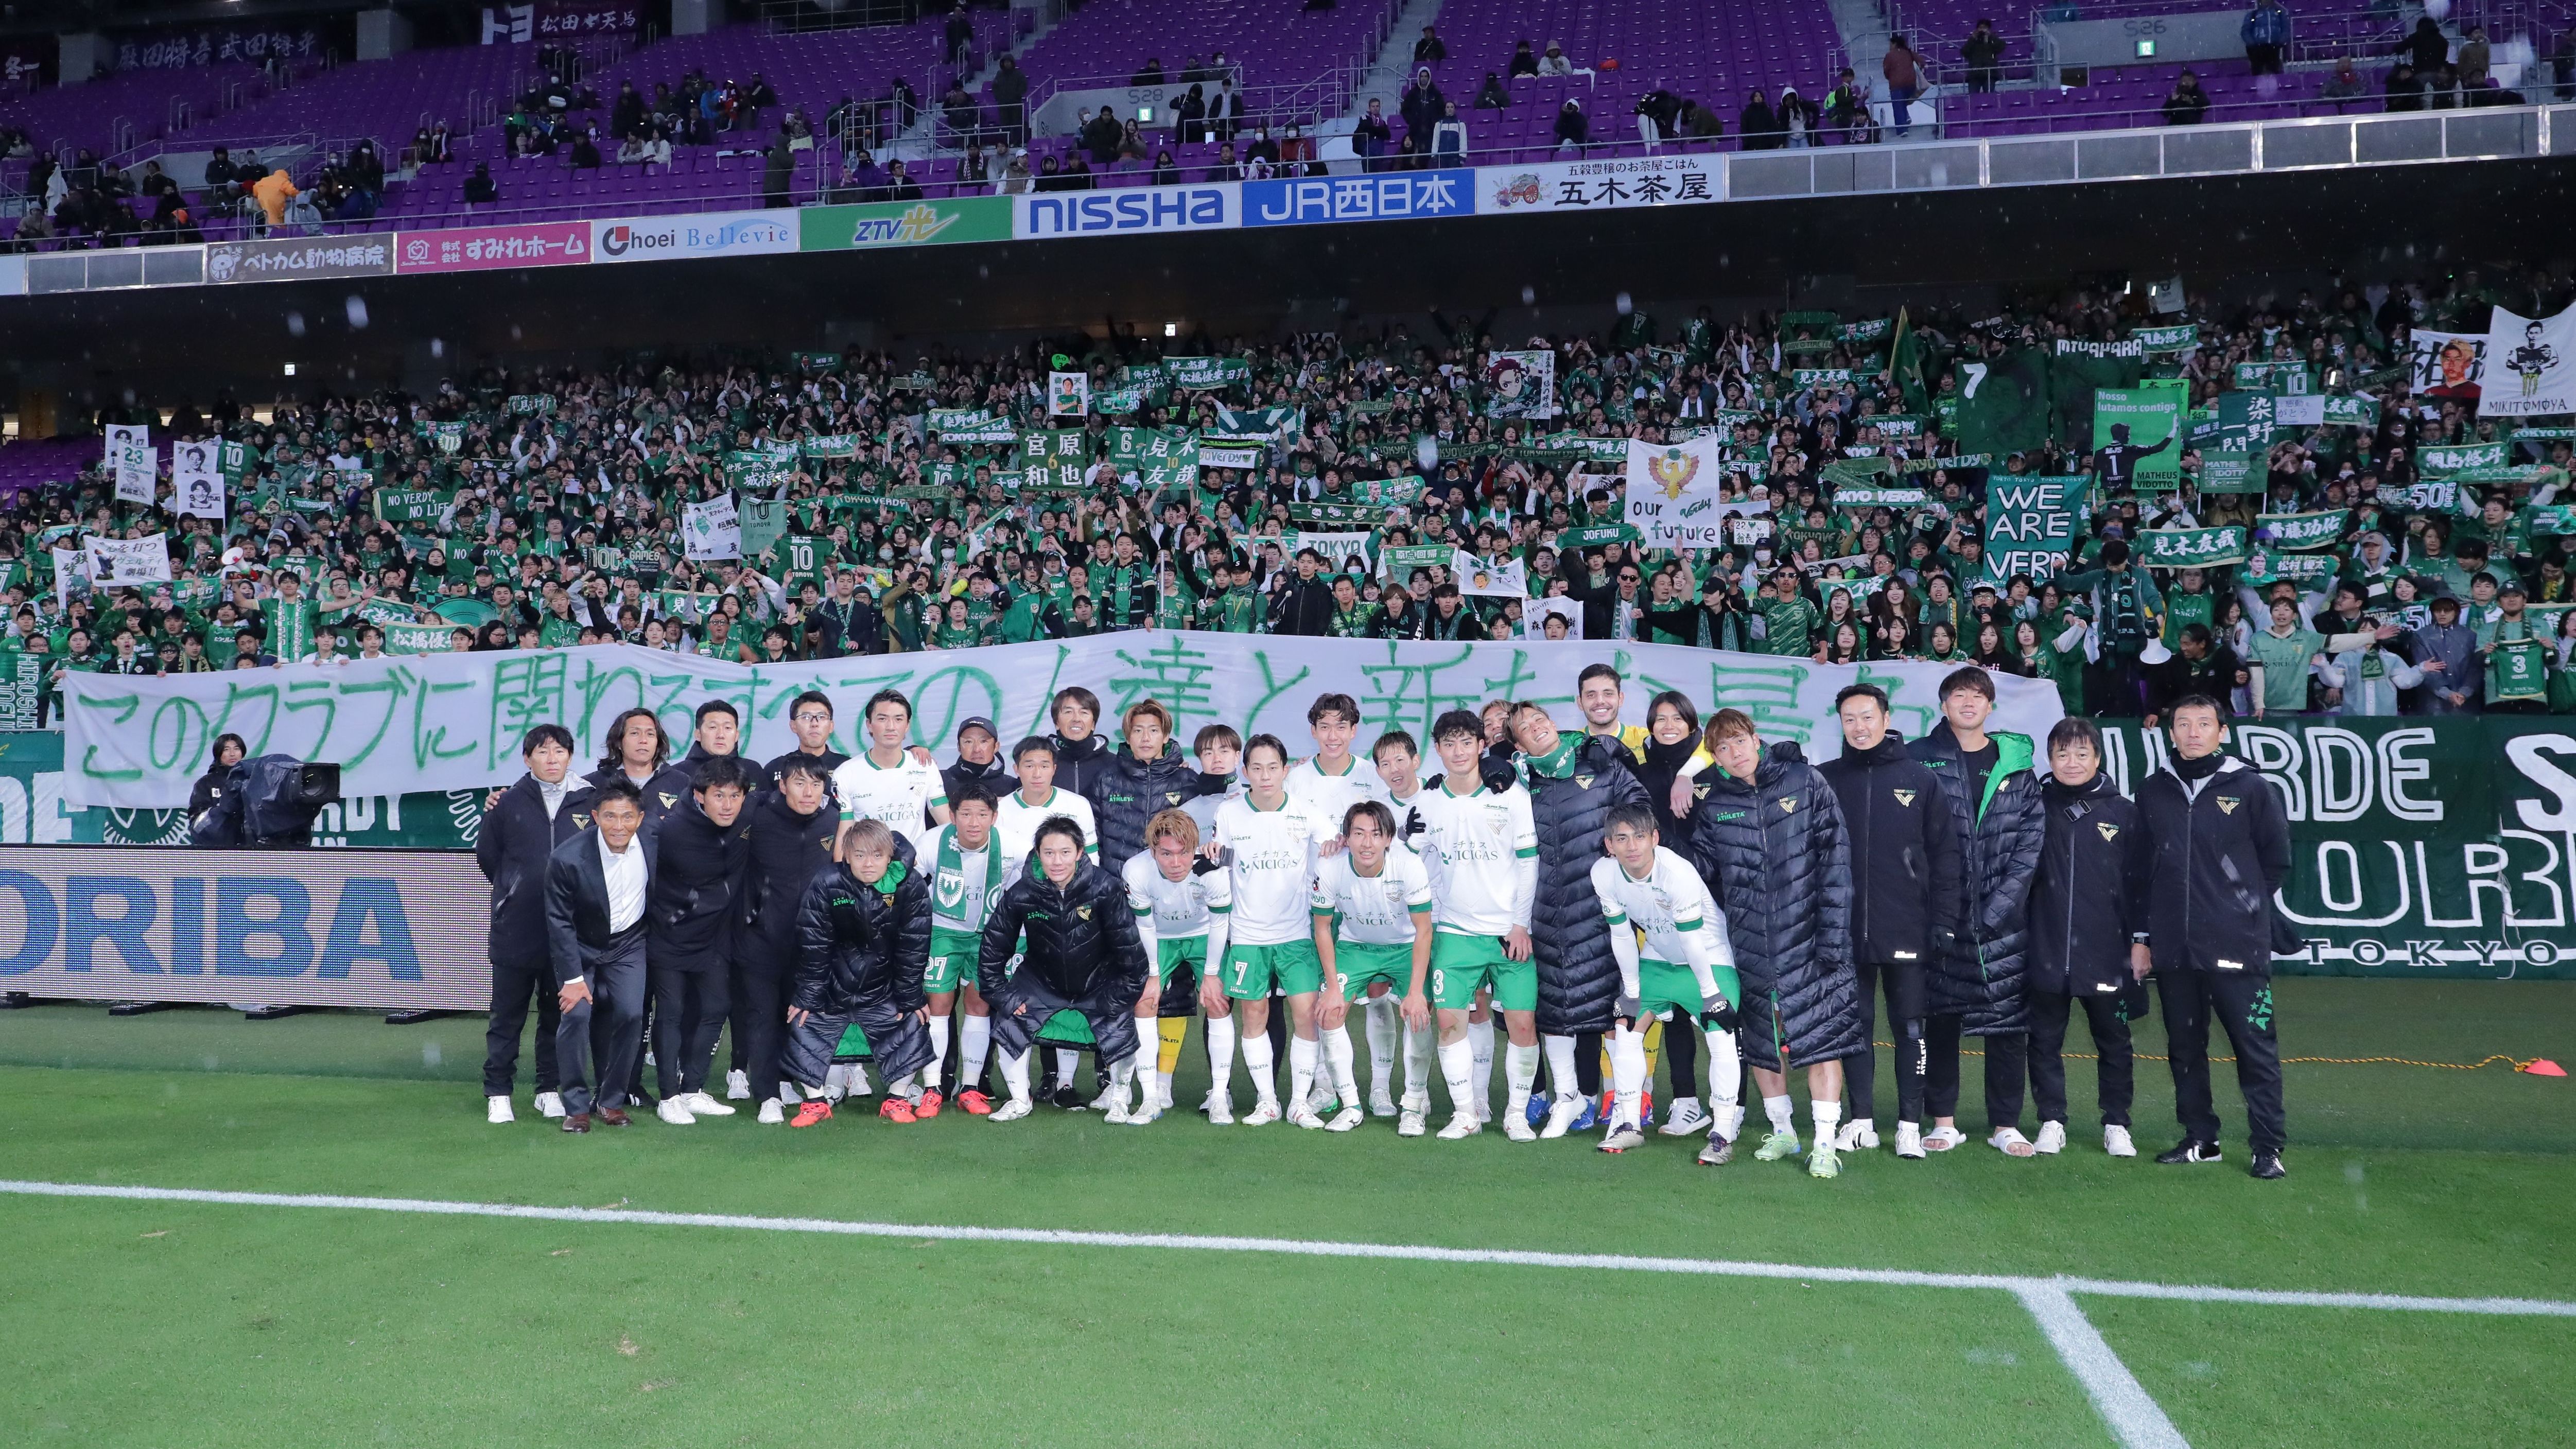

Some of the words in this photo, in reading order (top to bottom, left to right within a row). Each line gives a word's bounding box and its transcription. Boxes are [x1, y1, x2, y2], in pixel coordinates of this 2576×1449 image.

[1567, 159, 1699, 177] 五穀豊穣のお茶屋ごはん
[1261, 173, 1456, 222] JR西日本
[1554, 172, 1714, 206] 五木茶屋
[441, 240, 460, 252] 株式
[465, 233, 585, 261] すみれホーム
[686, 226, 789, 249] Bellevie
[243, 243, 385, 273] ベトカム動物病院
[441, 251, 461, 264] 会社
[1179, 369, 1224, 384] 松橋優安
[1962, 363, 1988, 399] 7
[2098, 391, 2128, 401] Nosso
[2098, 401, 2138, 412] lutamos
[2139, 401, 2177, 414] contigo
[2247, 396, 2275, 444] 染野
[807, 435, 854, 450] 千田海人
[941, 432, 978, 442] TOKYO
[980, 432, 1017, 442] VERDY
[1024, 432, 1082, 457] 宮原
[1121, 432, 1133, 453] 6
[1147, 435, 1198, 458] 見木
[124, 446, 144, 465] 23
[225, 446, 244, 467] 10
[1047, 452, 1058, 471] 6
[1167, 456, 1179, 469] 10
[1024, 463, 1083, 486] 和也
[1147, 462, 1199, 485] 友哉
[2109, 455, 2118, 476] 1
[2136, 480, 2174, 488] VIDOTTO
[2137, 471, 2178, 480] MATHEUS
[388, 495, 401, 506] NO
[403, 491, 436, 504] VERDY,
[1995, 484, 2064, 510] WE
[2413, 483, 2447, 510] 50
[409, 505, 423, 518] NO
[1633, 501, 1663, 516] our
[1582, 527, 1620, 541] JOFUKU
[1650, 520, 1716, 543] future
[1989, 512, 2073, 542] ARE
[791, 536, 812, 544] MJS
[1308, 539, 1361, 556] TOKYO
[2153, 529, 2237, 556] 見木友哉
[453, 548, 467, 560] NO
[629, 550, 660, 562] GAMES
[789, 545, 814, 571] 10
[1395, 548, 1438, 561] 原点回帰
[1986, 549, 2070, 580] VERD
[393, 630, 451, 650] 松橋優
[2362, 658, 2382, 673] 22
[2511, 655, 2526, 673] 3
[16, 653, 39, 729] HIROSHI
[877, 802, 914, 812] ニチガス
[878, 810, 920, 822] NICIGAS
[1716, 812, 1746, 823] ATHLETA
[1252, 850, 1291, 859] ニチガス
[1252, 858, 1299, 871] NICIGAS
[2307, 939, 2560, 966] TOKYO
[924, 956, 947, 981] 27
[1235, 961, 1248, 986] 7
